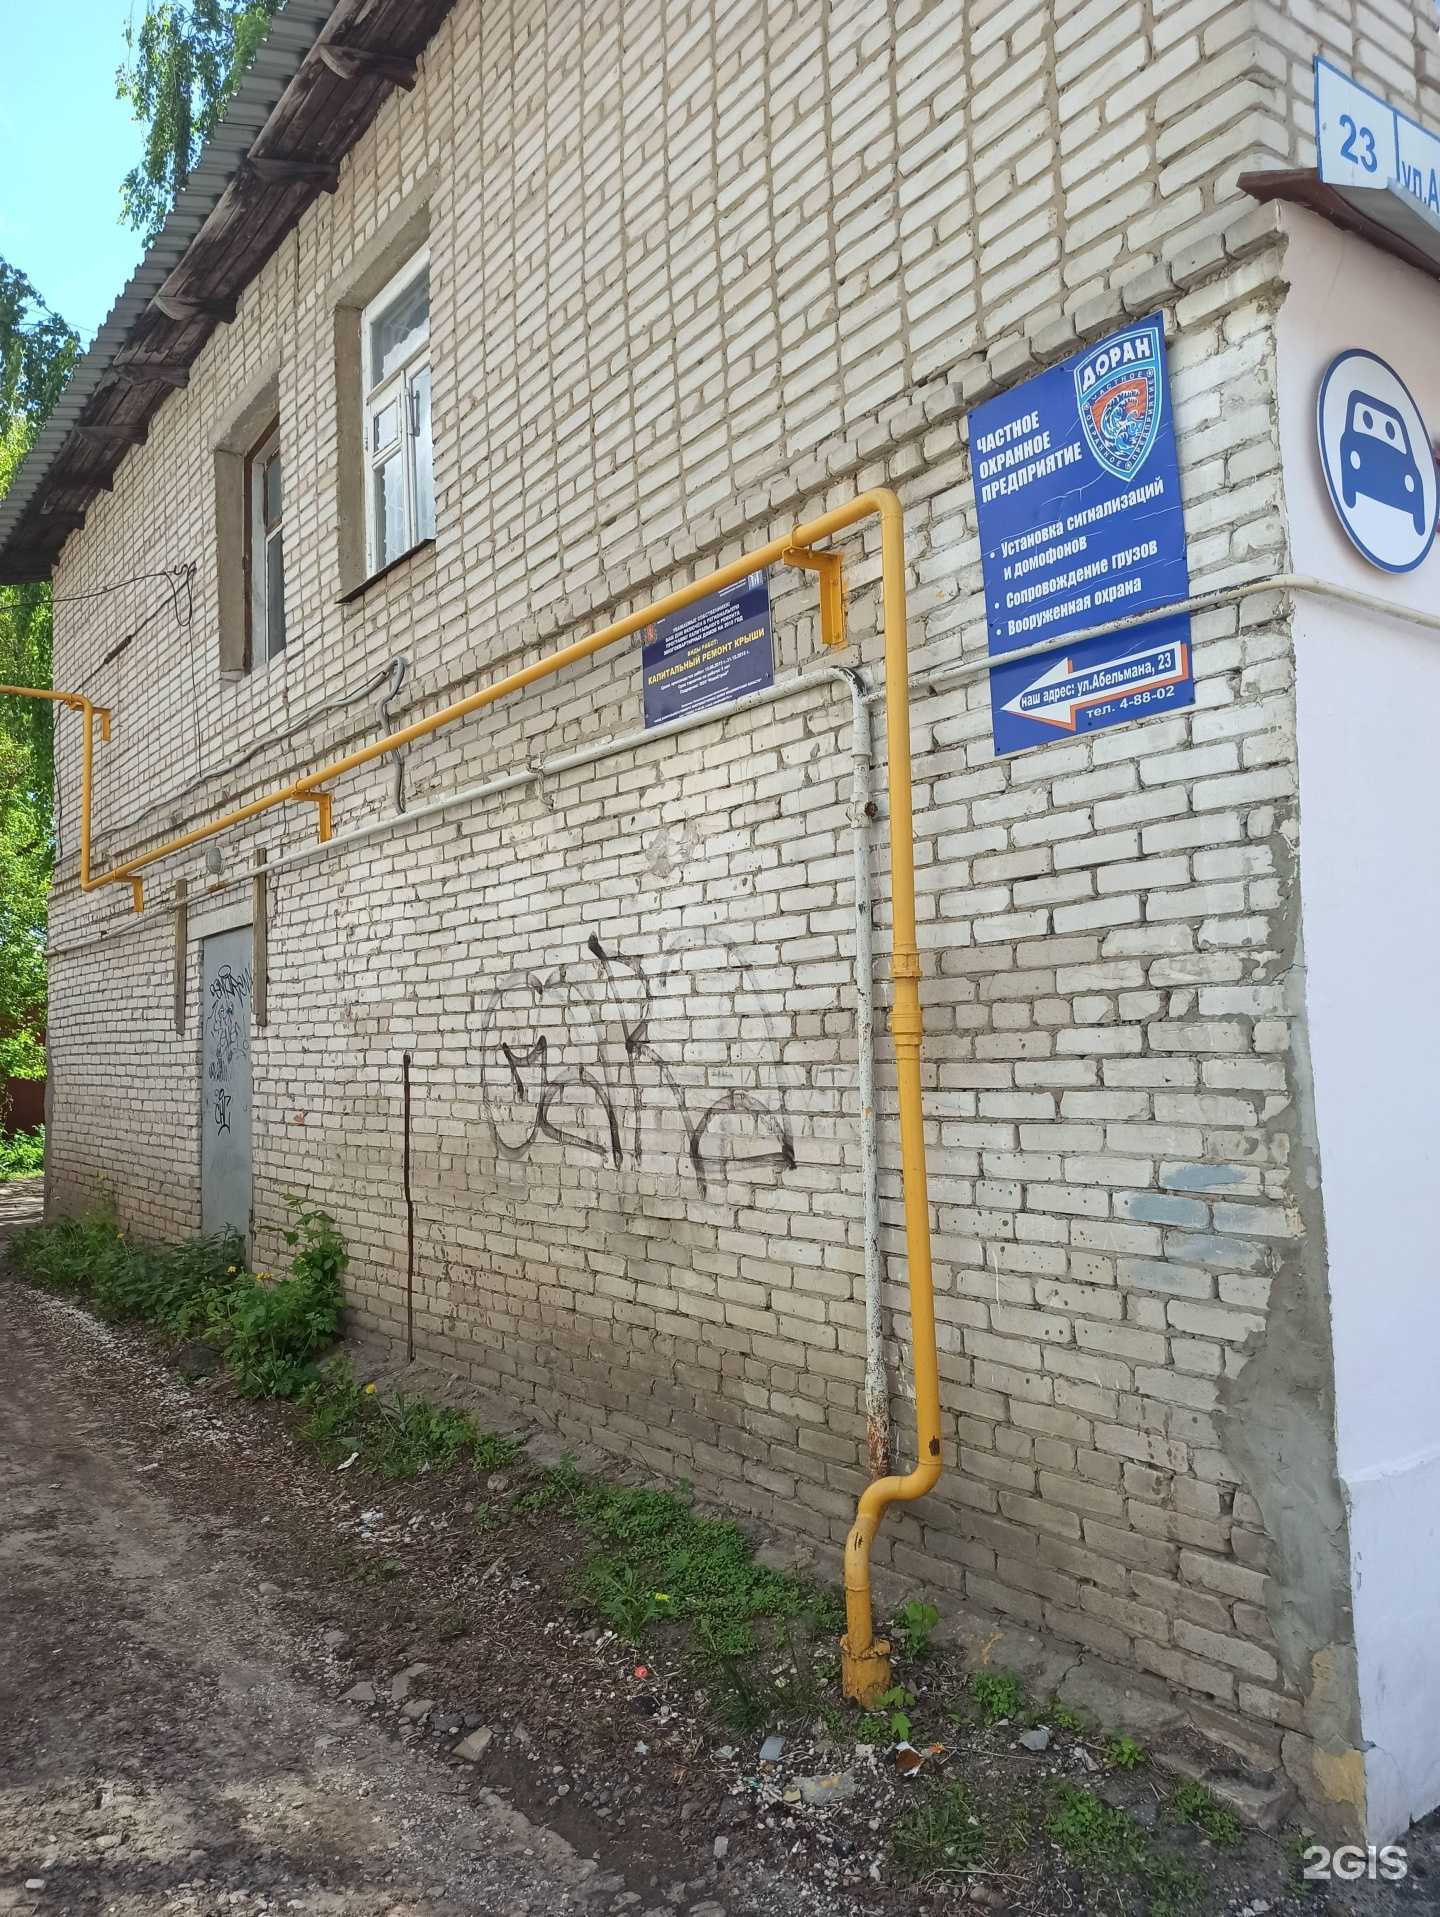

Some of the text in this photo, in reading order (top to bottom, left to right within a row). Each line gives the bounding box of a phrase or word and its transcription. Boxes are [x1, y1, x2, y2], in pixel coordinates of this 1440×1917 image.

[1339, 114, 1378, 173] 23
[1083, 336, 1151, 392] ДОРАН
[977, 410, 1040, 454] ЧАСТНОЕ
[979, 431, 1051, 479] ОХРАННОЕ
[981, 441, 1083, 503] ПРЕДПРИЯТИЕ
[1000, 477, 1164, 558] Установка сигнализаций
[1003, 536, 1088, 580] и домофонов
[1006, 539, 1158, 608] Сопровождение грузов
[1008, 577, 1142, 635] Вооруженная охрана
[648, 652, 701, 685] КАПИТАЛЬНЫЙ
[702, 642, 733, 663] РЕМОНТ
[734, 628, 765, 647] КРЫШИ
[1042, 685, 1075, 705] адрес:
[1158, 653, 1172, 670] 23
[1086, 685, 1175, 719] тел. 4-88-02
